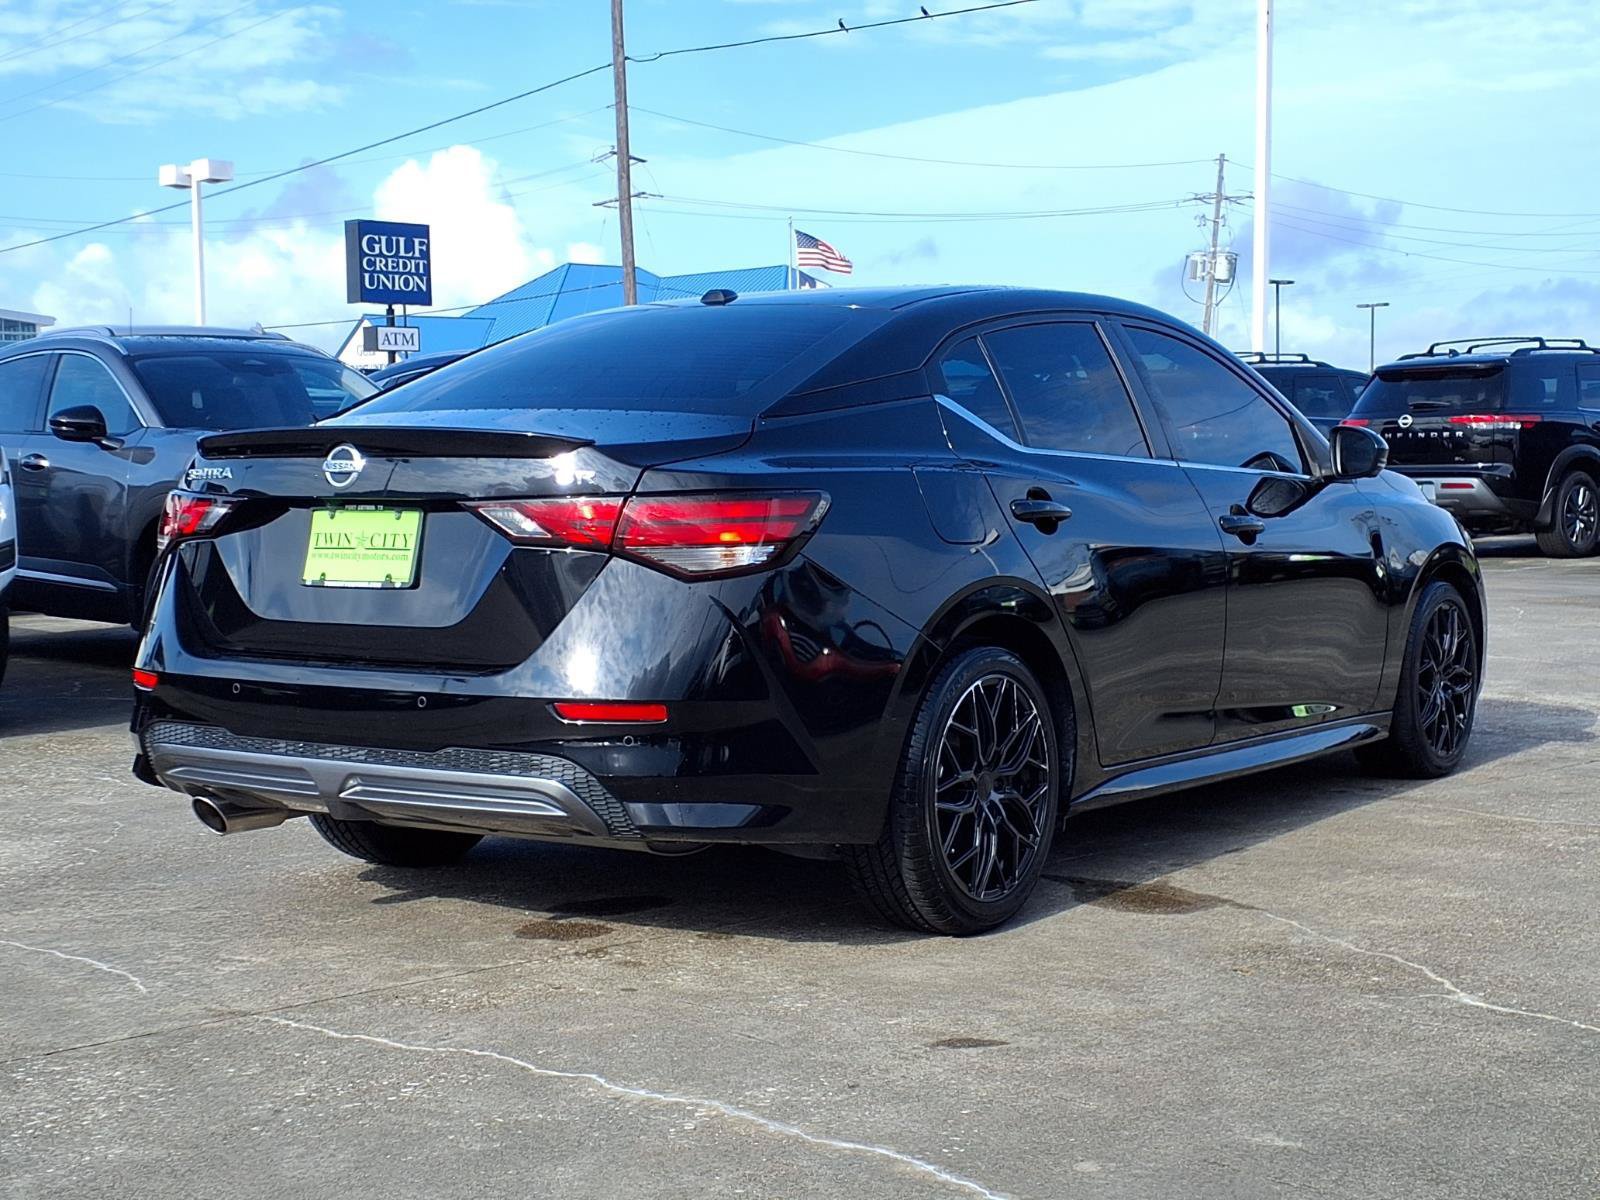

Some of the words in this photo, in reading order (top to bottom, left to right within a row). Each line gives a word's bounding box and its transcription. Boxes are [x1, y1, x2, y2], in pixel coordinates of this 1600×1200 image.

[361, 234, 428, 258] GULF
[362, 256, 428, 274] CREDIT
[363, 273, 427, 292] UNION
[381, 332, 416, 346] ATM
[1384, 431, 1464, 439] HFINDER
[325, 462, 357, 470] NISSAN
[187, 467, 233, 480] SENTRA
[314, 532, 354, 547] TWIN
[369, 532, 414, 549] CITY
[311, 551, 409, 562] www.twincitymotors.com
